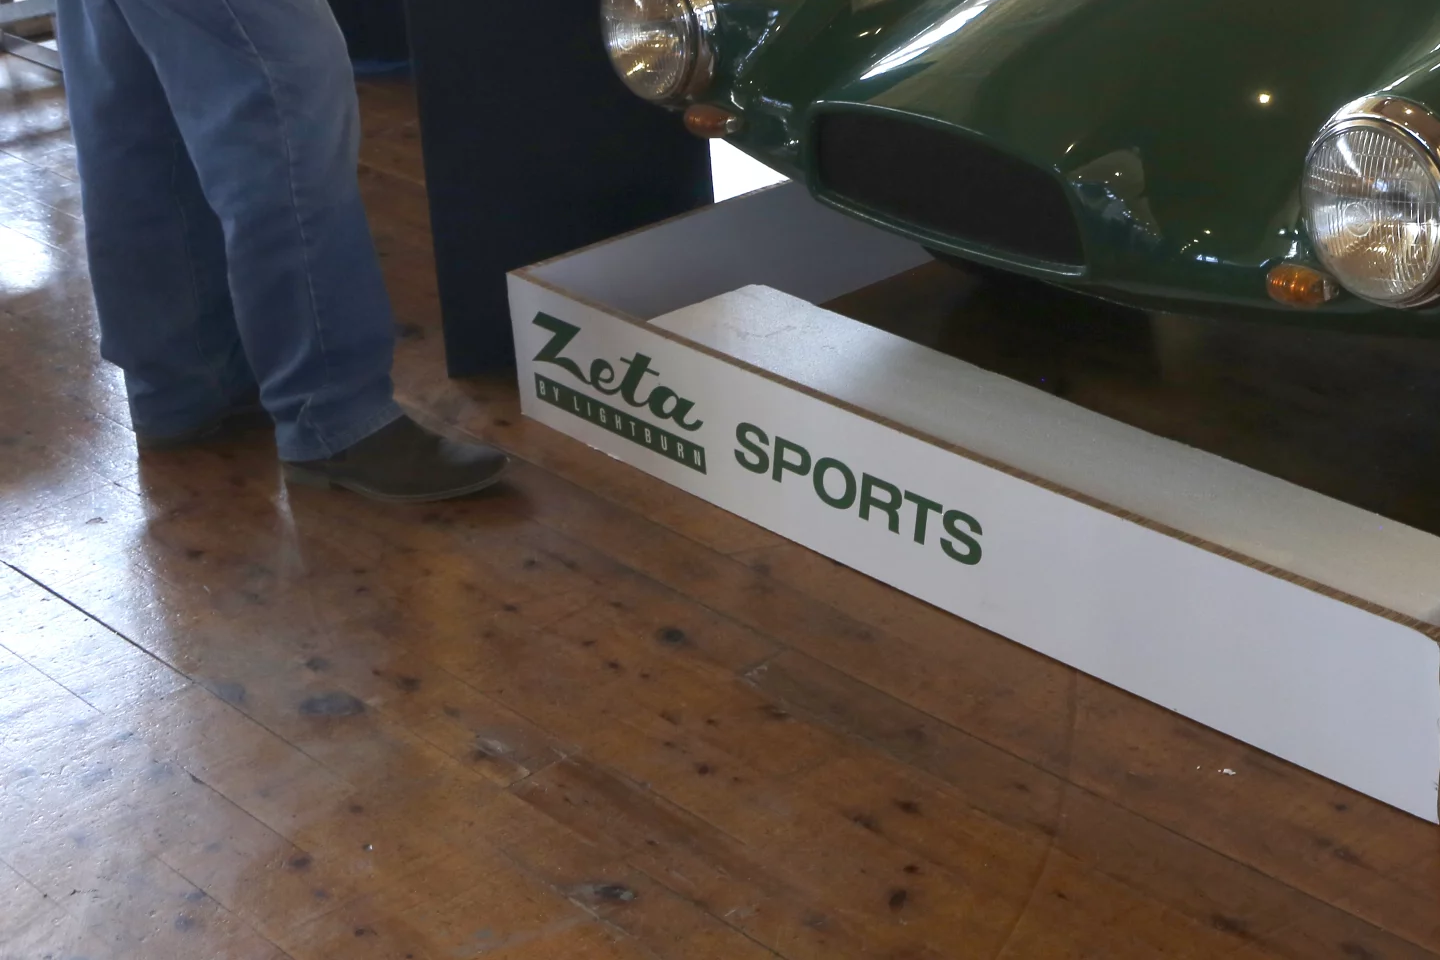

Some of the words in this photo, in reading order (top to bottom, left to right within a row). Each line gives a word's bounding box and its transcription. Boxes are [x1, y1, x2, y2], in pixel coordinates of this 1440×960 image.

[532, 311, 704, 432] Zeta
[539, 380, 560, 402] BY
[573, 395, 702, 466] LIGHTBURN
[734, 422, 983, 566] SPORTS
